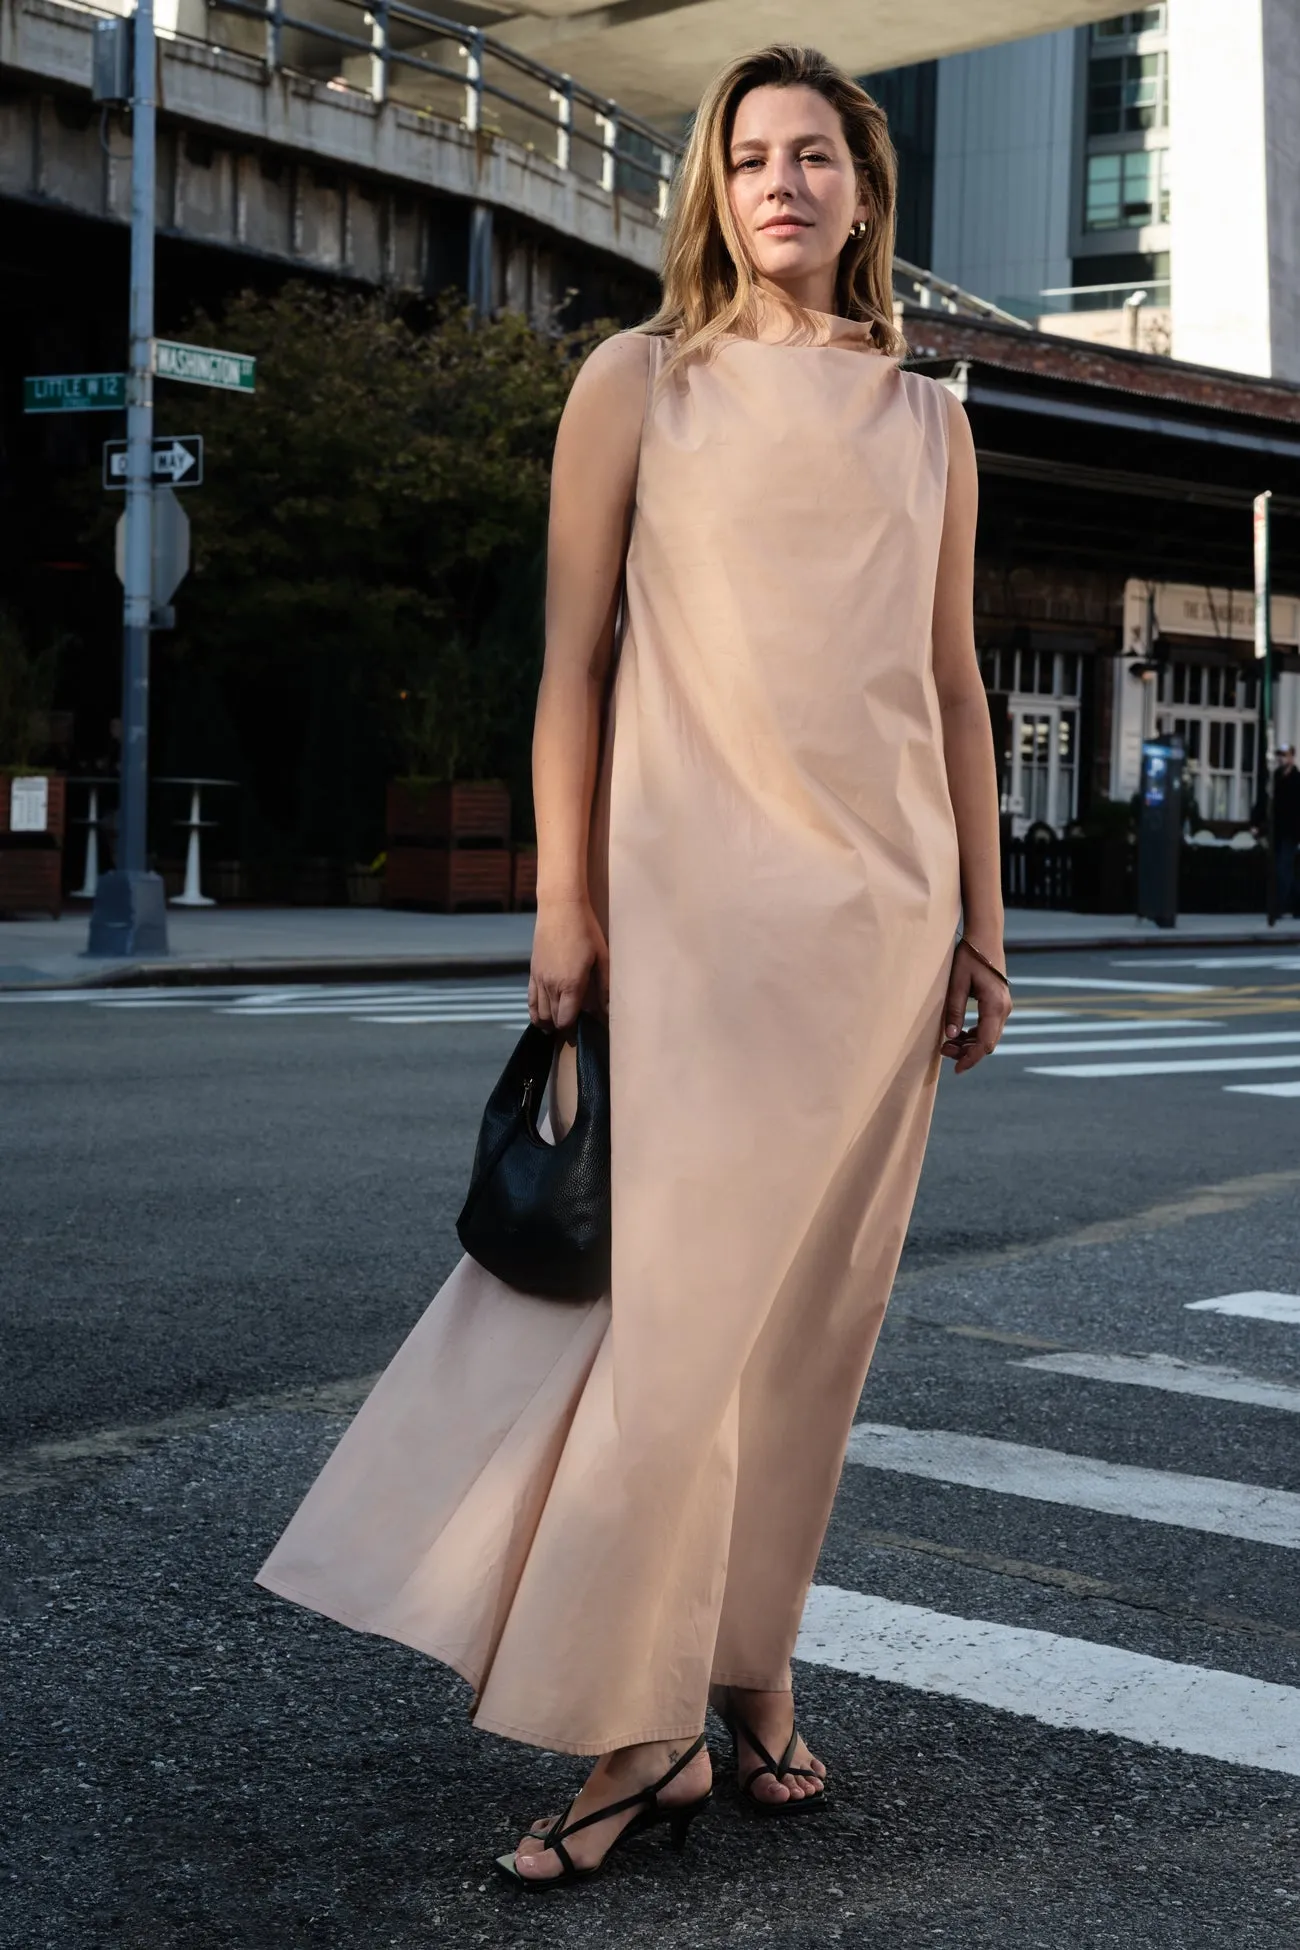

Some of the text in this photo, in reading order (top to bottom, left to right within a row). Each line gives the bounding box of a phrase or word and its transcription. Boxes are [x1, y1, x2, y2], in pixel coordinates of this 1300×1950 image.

[158, 346, 240, 385] WASHINGTON
[34, 380, 82, 398] LITTLE
[103, 378, 118, 396] 12
[158, 454, 185, 470] WAY
